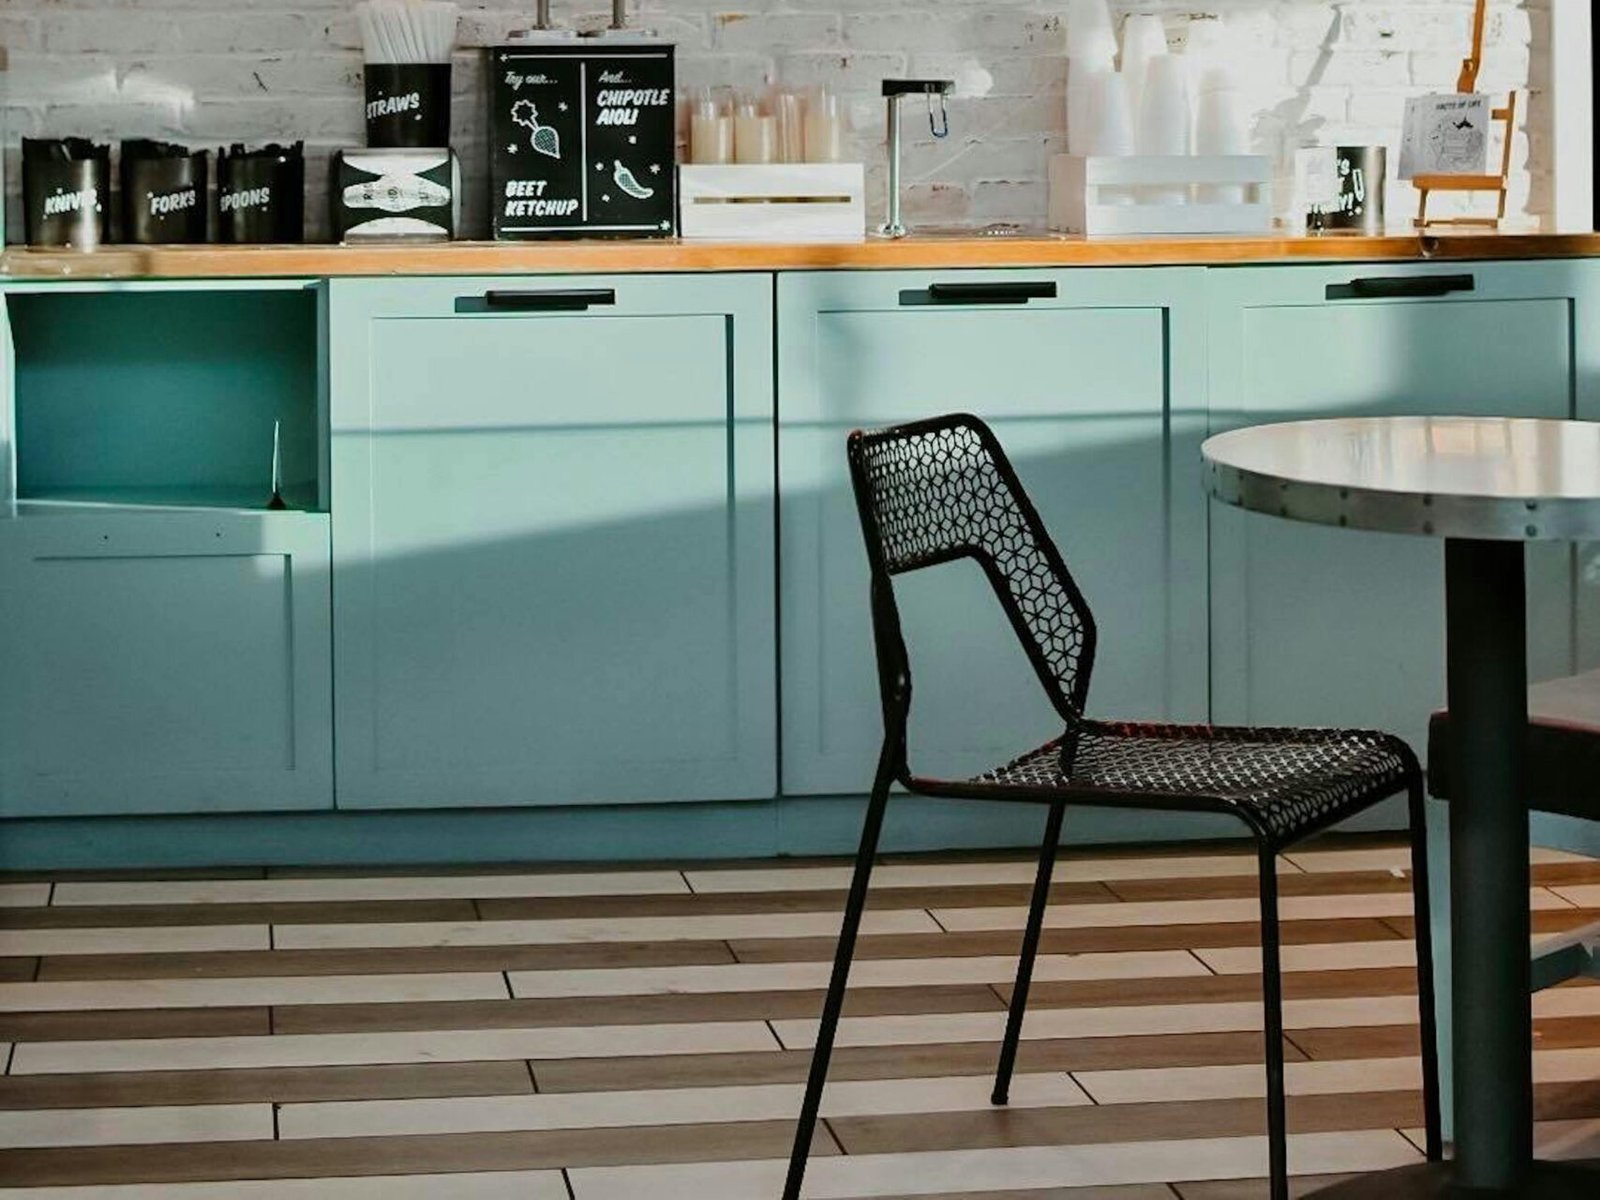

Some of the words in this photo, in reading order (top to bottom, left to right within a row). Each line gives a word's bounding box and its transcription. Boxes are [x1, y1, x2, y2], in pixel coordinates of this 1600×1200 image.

[505, 71, 524, 90] Try
[366, 91, 420, 120] STRAWS
[596, 88, 671, 107] CHIPOTLE
[595, 108, 639, 126] AIOLI
[505, 180, 548, 198] BEET
[151, 190, 196, 215] FORKS
[505, 199, 579, 217] KETCHUP
